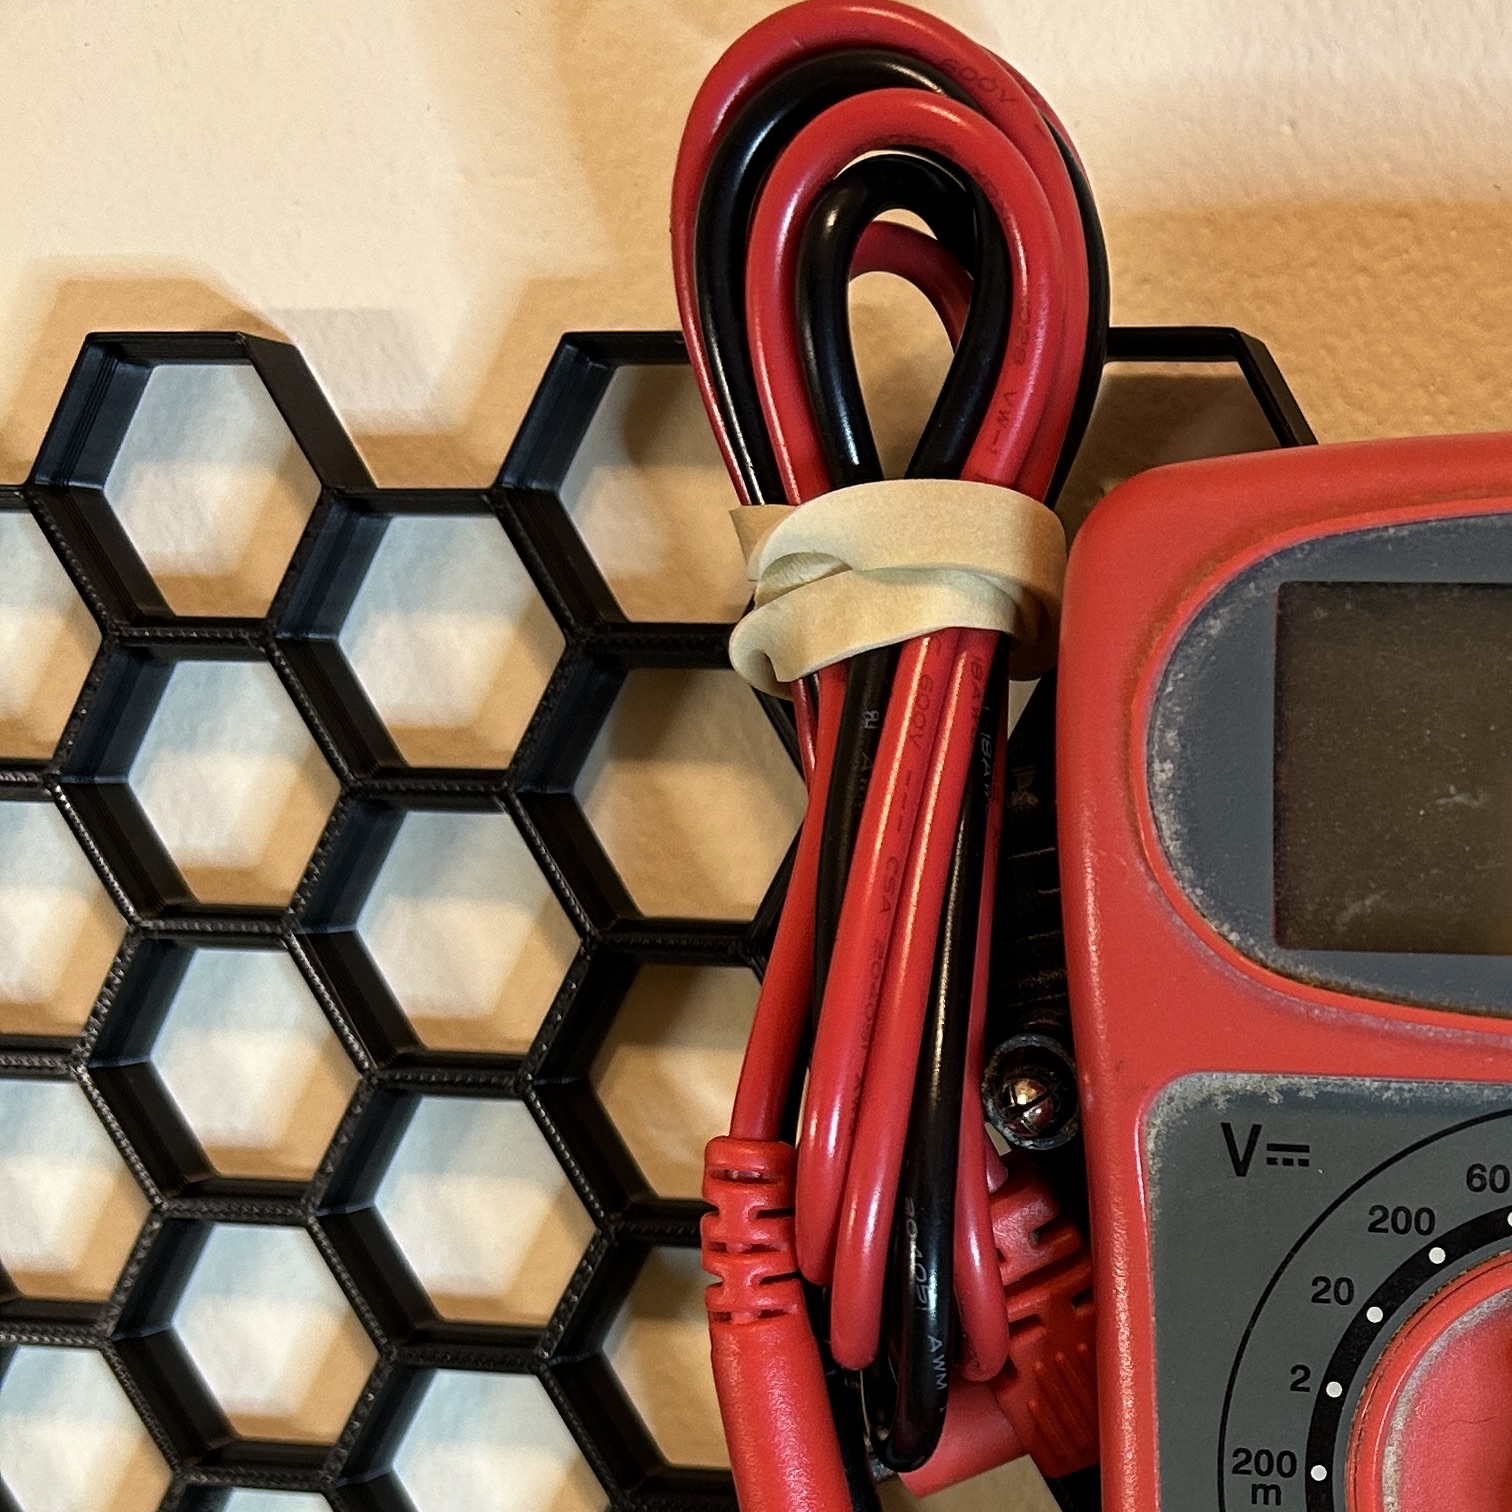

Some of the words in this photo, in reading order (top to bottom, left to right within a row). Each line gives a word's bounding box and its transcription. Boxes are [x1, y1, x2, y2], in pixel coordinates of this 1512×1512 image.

[1368, 1206, 1436, 1236] 200
[1311, 1276, 1354, 1305] 20
[1290, 1365, 1311, 1392] 2
[1232, 1448, 1297, 1477] 200
[1251, 1483, 1282, 1505] m
